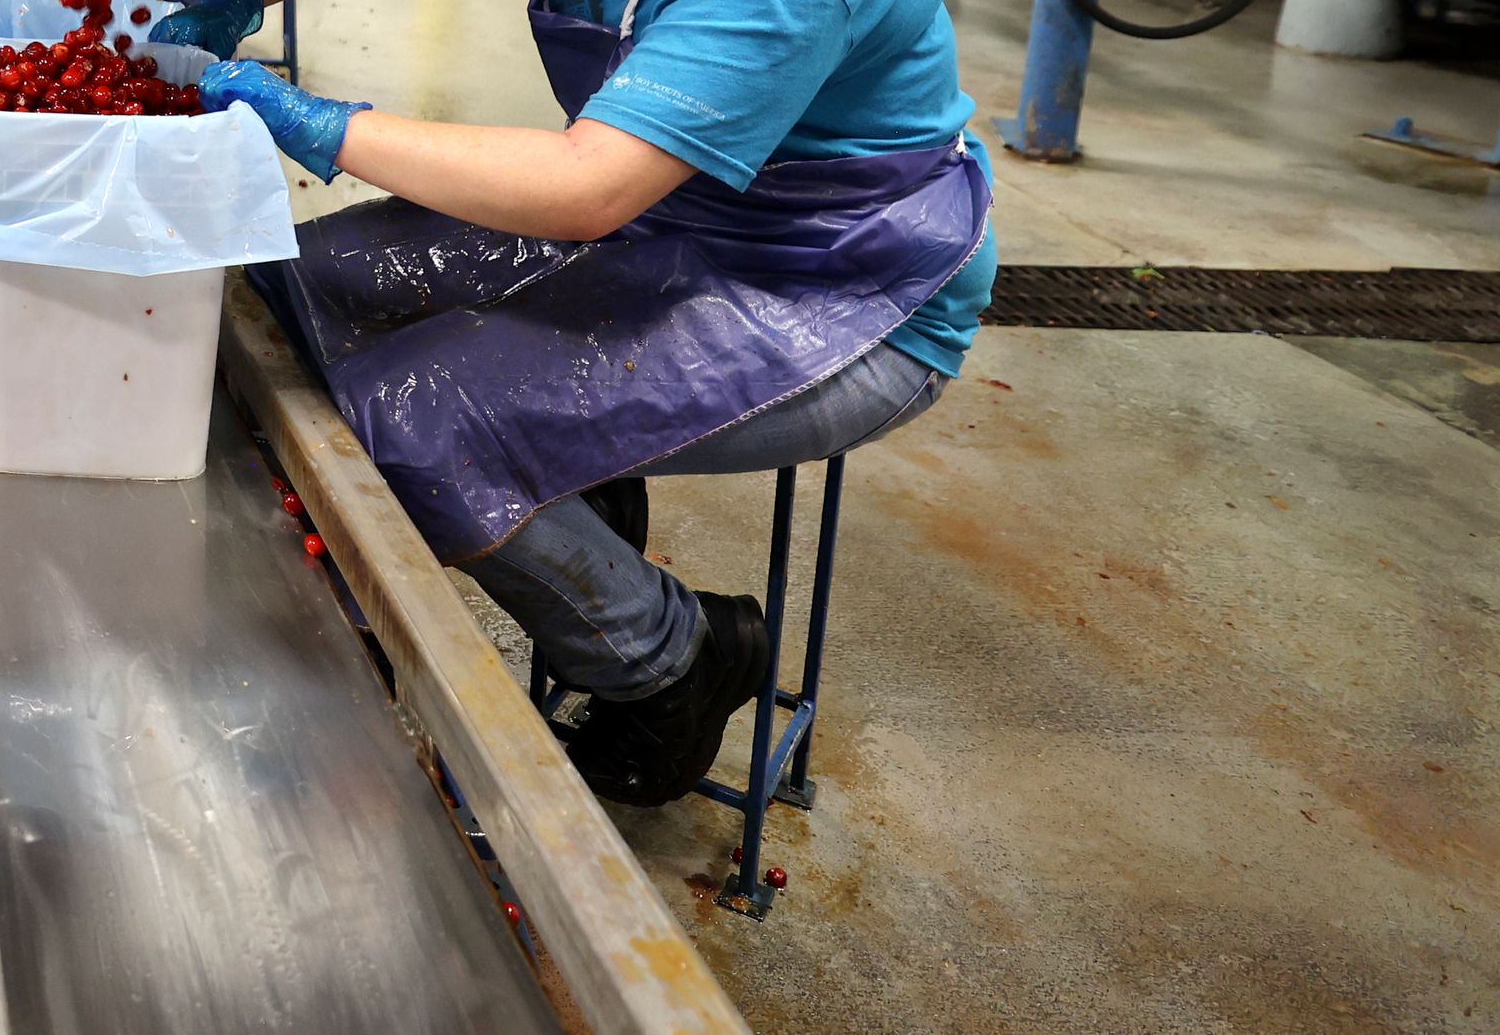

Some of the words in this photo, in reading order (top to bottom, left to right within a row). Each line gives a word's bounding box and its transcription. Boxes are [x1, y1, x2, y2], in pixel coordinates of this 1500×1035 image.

[635, 77, 653, 86] BOY
[652, 82, 683, 99] SCOUTS
[682, 95, 697, 103] OF
